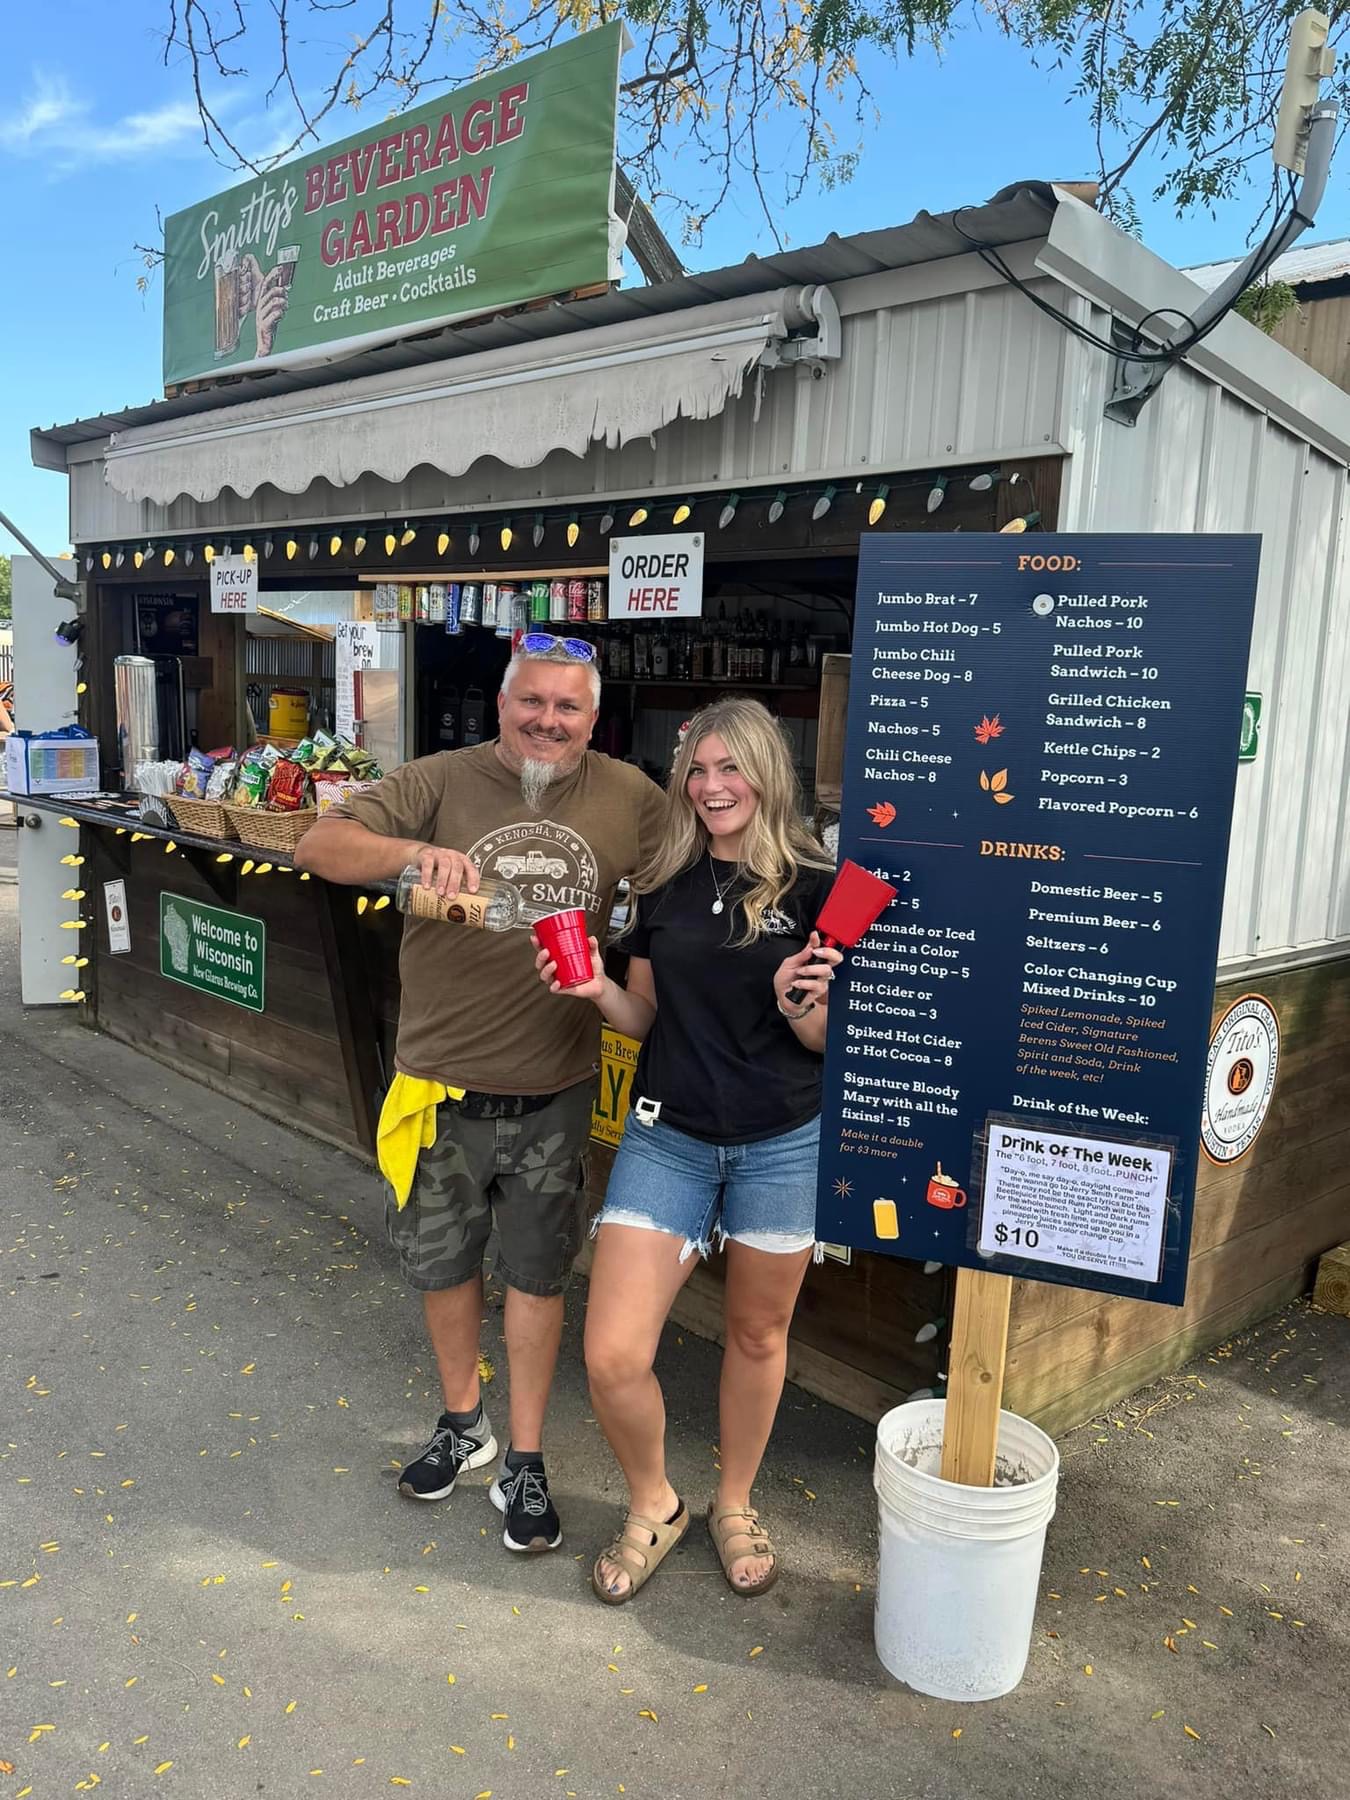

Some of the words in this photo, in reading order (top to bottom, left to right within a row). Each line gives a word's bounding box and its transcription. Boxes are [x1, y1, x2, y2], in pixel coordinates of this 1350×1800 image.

[305, 82, 530, 215] BEVERAGE
[321, 166, 496, 268] GARDEN
[198, 179, 298, 280] Smitty's
[334, 260, 373, 293] Adult
[377, 244, 456, 282] Beverages
[313, 300, 350, 322] Craft
[354, 292, 388, 313] Beer
[400, 265, 476, 302] Cocktails
[621, 553, 689, 579] ORDER
[1018, 556, 1081, 570] FOOD:
[216, 570, 252, 586] PICK-UP
[220, 593, 247, 608] HERE
[627, 587, 680, 611] HERE
[878, 592, 922, 604] Jumbo
[925, 593, 955, 604] Brat
[970, 594, 977, 605] 7
[1058, 595, 1107, 607] Pulled
[1111, 596, 1148, 607] Pork
[876, 621, 919, 632] Jumbo
[923, 622, 948, 632] Hot
[952, 622, 978, 636] Dog
[993, 623, 1001, 634] 5
[1056, 616, 1112, 628] Nachos
[1127, 617, 1142, 628] 10
[338, 622, 348, 638] Get
[349, 625, 366, 645] your
[354, 641, 373, 657] brew
[874, 648, 917, 660] Jumbo
[921, 649, 954, 661] Chili
[1053, 645, 1102, 656] Pulled
[1106, 646, 1142, 658] Pork
[872, 668, 921, 679] Cheese
[924, 669, 949, 683] Dog
[965, 671, 972, 681] 8
[1051, 665, 1126, 678] Sandwich
[1142, 668, 1158, 679] 10
[1049, 694, 1102, 706] Grilled
[1106, 696, 1170, 709] Chicken
[1046, 714, 1121, 728] Sandwich
[1138, 718, 1145, 729] 8
[866, 749, 899, 760] Chili
[903, 751, 951, 763] Cheese
[1044, 742, 1089, 755] Kettle
[1093, 743, 1136, 760] Chips
[1152, 747, 1160, 758] 2
[865, 768, 914, 781] Nachos
[929, 772, 936, 782] 8
[1041, 770, 1104, 785] Popcorn
[1119, 774, 1127, 785] 3
[1039, 798, 1105, 812] Flavored
[1109, 802, 1173, 817] Popcorn
[1190, 807, 1198, 818] 6
[555, 831, 570, 842] WI
[981, 841, 1065, 860] DRINKS:
[532, 883, 602, 913] SMITH
[1031, 882, 1100, 897] Domestic
[1104, 888, 1138, 900] Beer
[1154, 892, 1162, 903] 5
[1029, 909, 1099, 925] Premium
[1103, 915, 1138, 928] Beer
[1153, 920, 1161, 931] 6
[192, 915, 240, 946] Welcome
[245, 930, 257, 952] to
[893, 942, 906, 952] in
[921, 945, 959, 958] Color
[1027, 936, 1085, 951] Seltzers
[1100, 943, 1108, 953] 6
[196, 939, 253, 975] Wisconsin
[852, 956, 917, 975] Changing
[921, 963, 948, 978] Cup
[962, 968, 969, 978] 5
[193, 964, 204, 979] New
[205, 969, 224, 986] Glarus
[225, 974, 248, 998] Brewing
[249, 985, 258, 998] Co.
[1025, 963, 1065, 976] Color
[1068, 967, 1142, 988] Changing
[1146, 976, 1176, 991] Cup
[1023, 982, 1070, 997] Mixed
[1073, 987, 1125, 1003] Drinks
[1141, 995, 1155, 1006] 10
[1021, 1004, 1058, 1015] Spiked
[1061, 1008, 1122, 1024] Lemonade,
[1126, 1016, 1165, 1028] Spiked
[1223, 1003, 1260, 1033] ORIGINAL
[847, 1025, 892, 1040] Spiked
[896, 1031, 920, 1043] Hot
[923, 1035, 962, 1048] Cider
[1020, 1019, 1044, 1029] Iced
[1046, 1022, 1078, 1034] Cider,
[1082, 1026, 1138, 1040] Signature
[1227, 1026, 1263, 1054] Tito's
[846, 1046, 860, 1054] or
[864, 1045, 887, 1057] Hot
[890, 1049, 930, 1063] Cocoa
[945, 1056, 952, 1066] 8
[1019, 1034, 1057, 1046] Berens
[1059, 1039, 1092, 1050] Sweet
[1095, 1043, 1114, 1053] Old
[1117, 1046, 1178, 1063] Fashioned,
[1018, 1049, 1048, 1060] Spirit
[1051, 1055, 1072, 1063] and
[1075, 1056, 1104, 1068] Soda,
[1109, 1060, 1140, 1072] Drink
[1017, 1064, 1029, 1074] of
[1030, 1065, 1047, 1075] the
[1050, 1070, 1079, 1080] week,
[1083, 1074, 1104, 1082] etc!
[844, 1072, 909, 1092] Signature
[913, 1081, 959, 1100] Bloody
[844, 1090, 880, 1107] Mary
[883, 1097, 912, 1109] with
[916, 1101, 933, 1112] all
[937, 1104, 958, 1115] the
[1013, 1095, 1055, 1111] Drink
[1059, 1103, 1073, 1113] of
[1075, 1104, 1098, 1117] the
[1102, 1108, 1148, 1124] Week:
[843, 1108, 883, 1123] fixins!
[898, 1116, 910, 1127] 15
[841, 1128, 869, 1140] Make
[890, 1136, 923, 1148] double
[1204, 1128, 1227, 1157] AUSTIN
[840, 1143, 855, 1152] for
[871, 1149, 897, 1158] more
[1002, 1135, 1044, 1153] Drink
[1050, 1144, 1069, 1156] Of
[1073, 1147, 1103, 1162] The
[1109, 1153, 1153, 1172] Week
[995, 1223, 1038, 1248] $10
